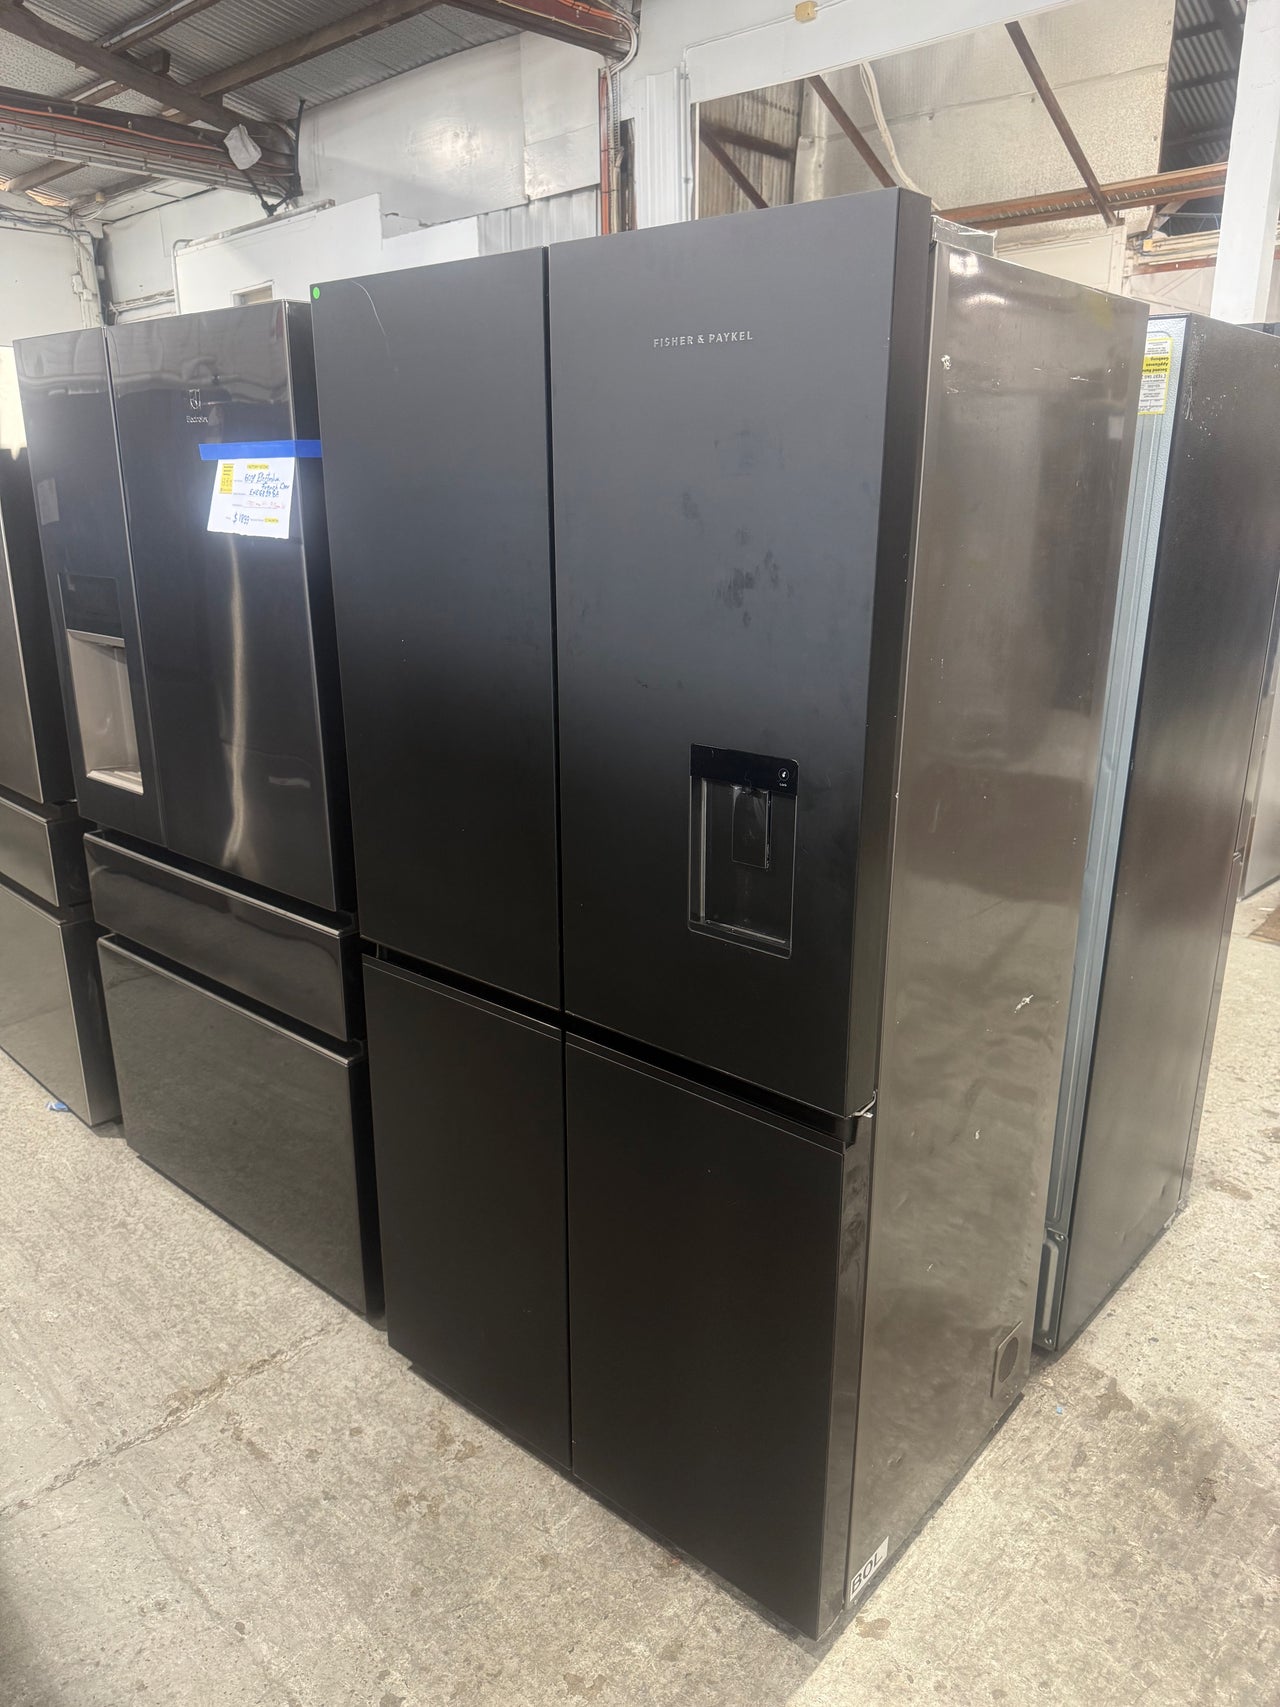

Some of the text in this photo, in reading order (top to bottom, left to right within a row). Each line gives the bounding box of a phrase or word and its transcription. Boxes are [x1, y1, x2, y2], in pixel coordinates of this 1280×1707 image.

[653, 331, 753, 348] FISHER & PAYKEL
[852, 1553, 883, 1595] BOL
